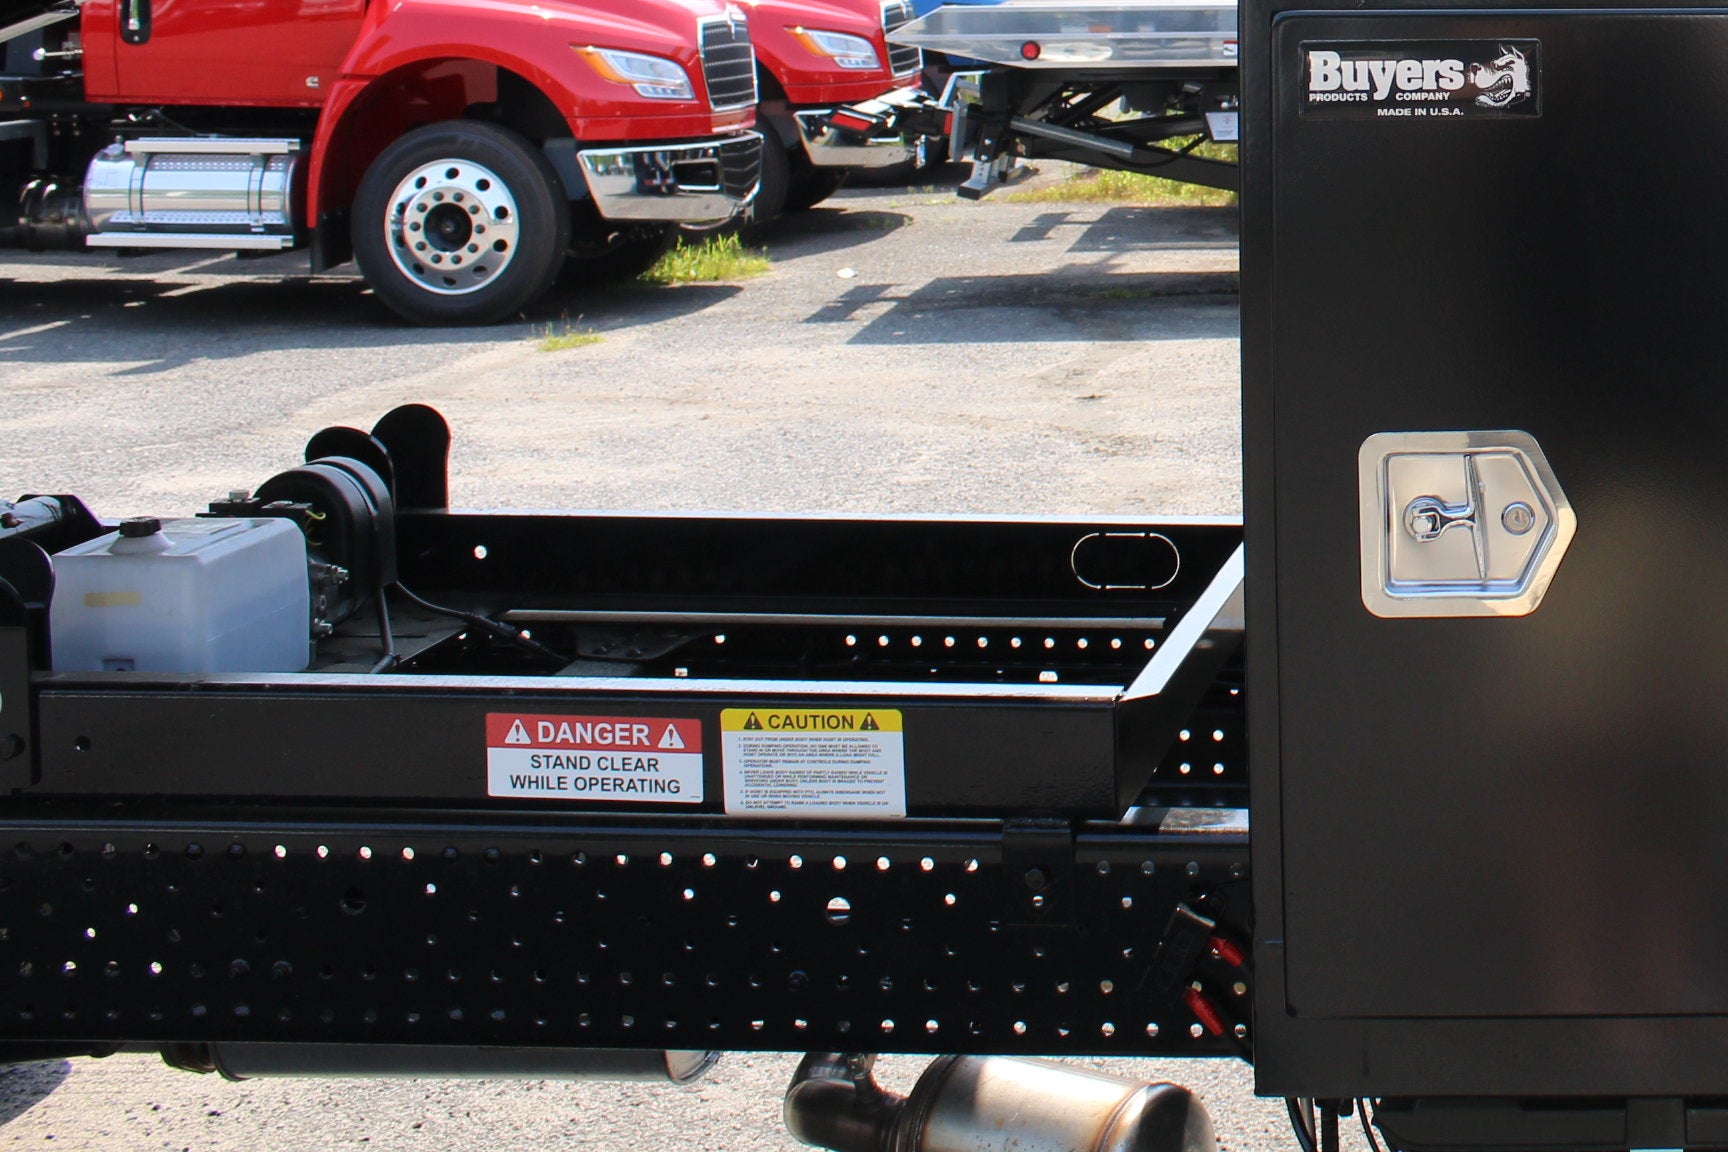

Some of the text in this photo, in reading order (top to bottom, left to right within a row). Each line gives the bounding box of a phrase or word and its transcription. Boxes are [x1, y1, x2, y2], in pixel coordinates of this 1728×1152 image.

[1308, 50, 1465, 101] Buyers
[1309, 91, 1450, 102] PRODUCTS COMPANY
[1377, 107, 1464, 116] MADE IN U.S.A.
[768, 714, 855, 730] CAUTION
[537, 720, 650, 747] DANGER
[530, 754, 659, 774] STAND CLEAR
[510, 774, 681, 795] WHILE OPERATING
